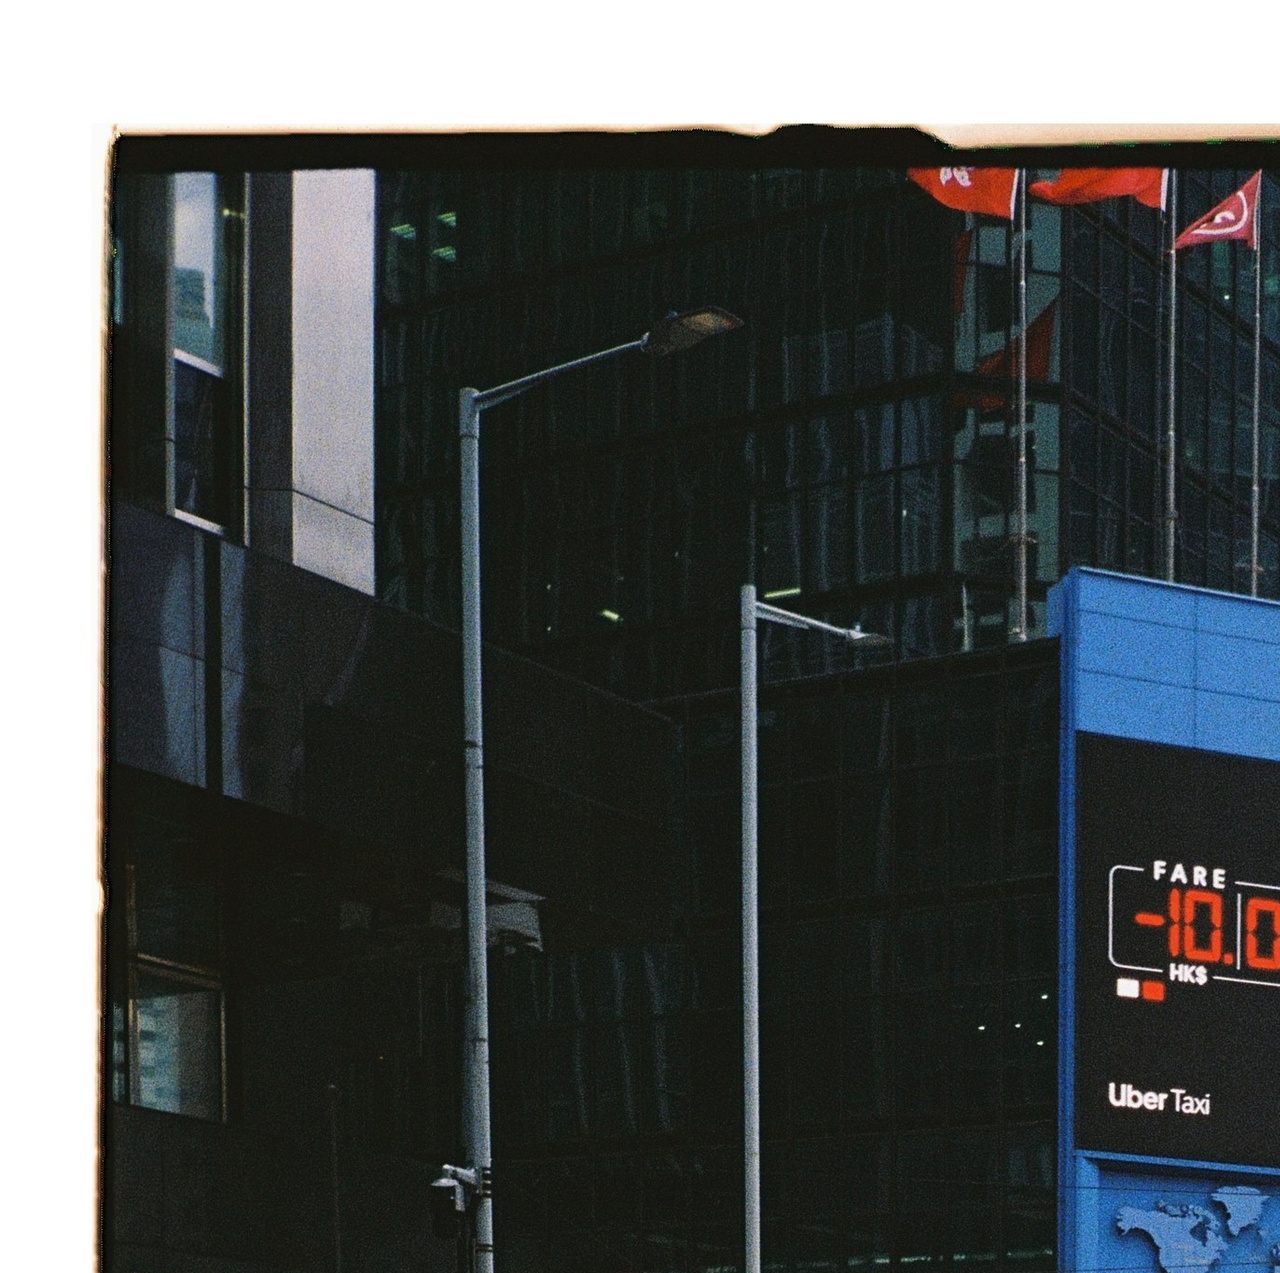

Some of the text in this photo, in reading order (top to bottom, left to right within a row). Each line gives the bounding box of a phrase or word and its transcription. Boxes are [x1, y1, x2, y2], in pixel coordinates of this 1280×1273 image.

[1152, 860, 1227, 889] FARE
[1168, 963, 1209, 985] HK$
[1108, 1082, 1210, 1116] Uber Taxi
